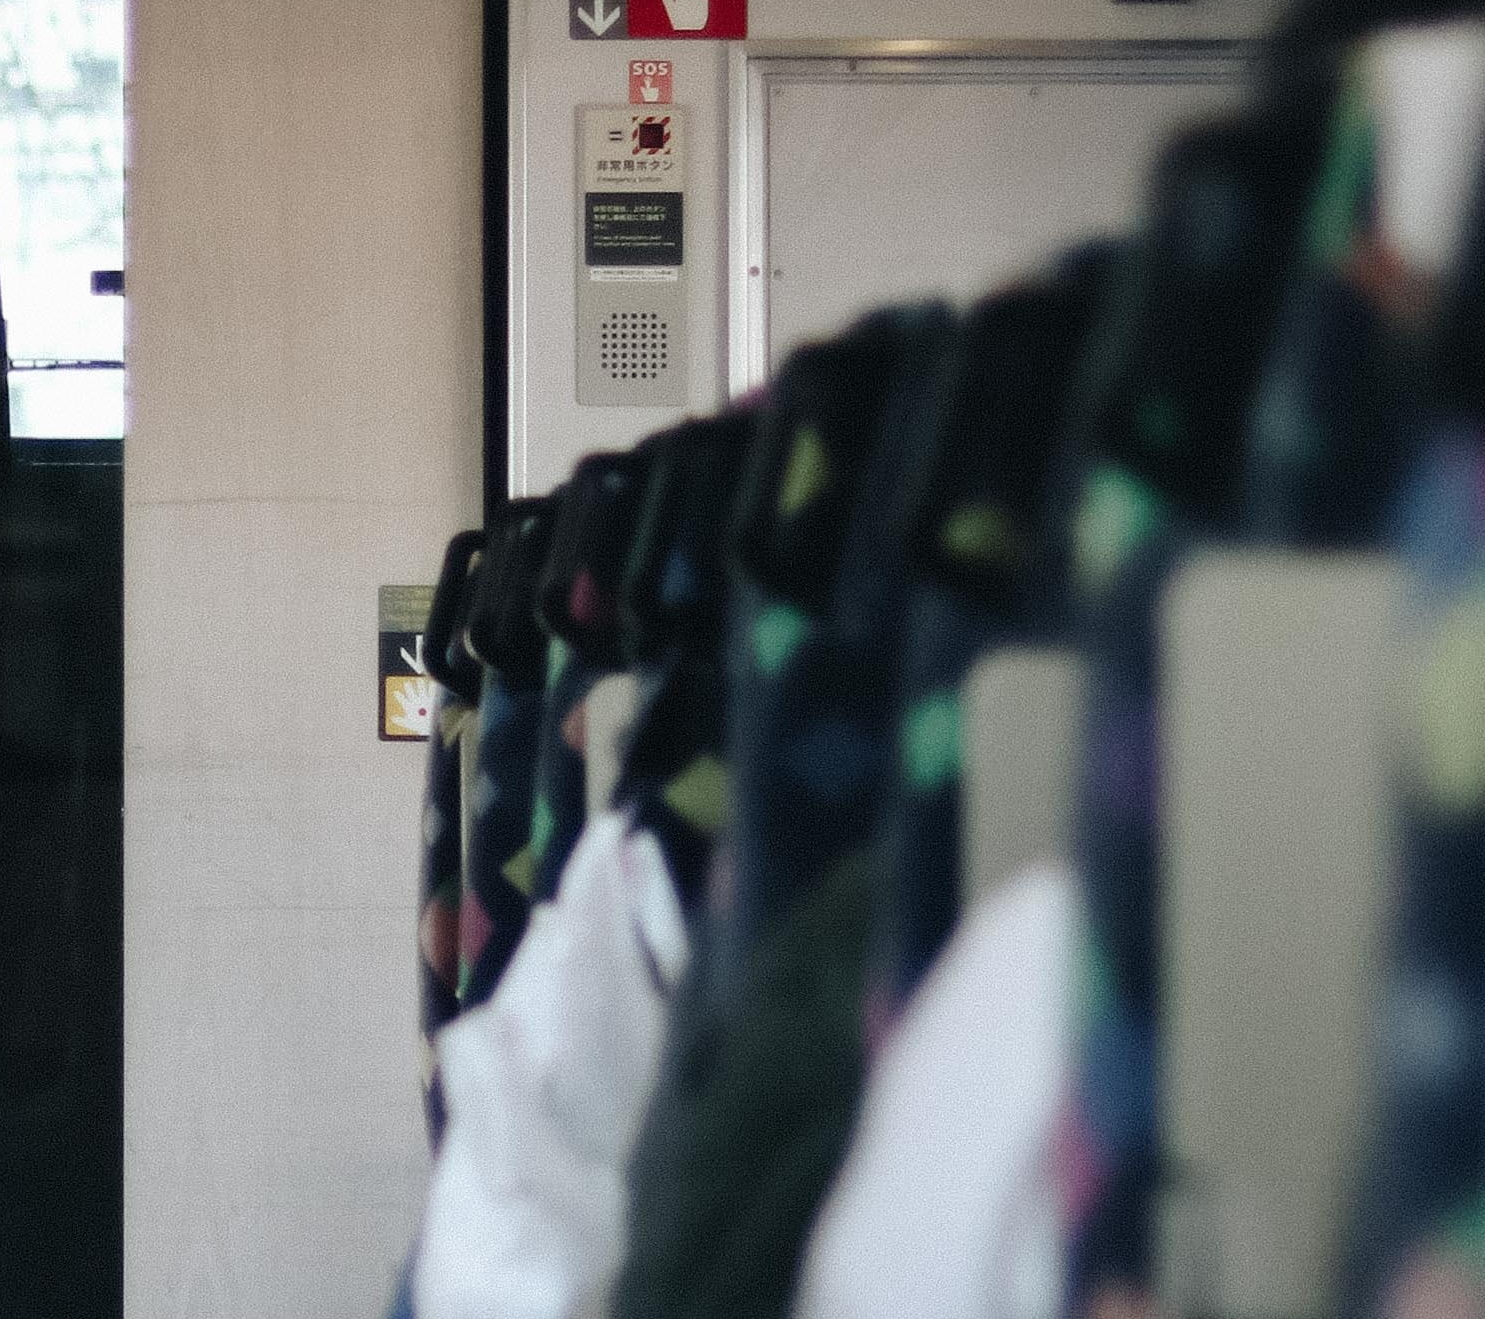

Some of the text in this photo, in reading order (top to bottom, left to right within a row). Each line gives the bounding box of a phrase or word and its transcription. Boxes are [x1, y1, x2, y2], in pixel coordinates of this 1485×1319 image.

[632, 62, 669, 77] SOS
[597, 159, 675, 172] 非常用ボタン
